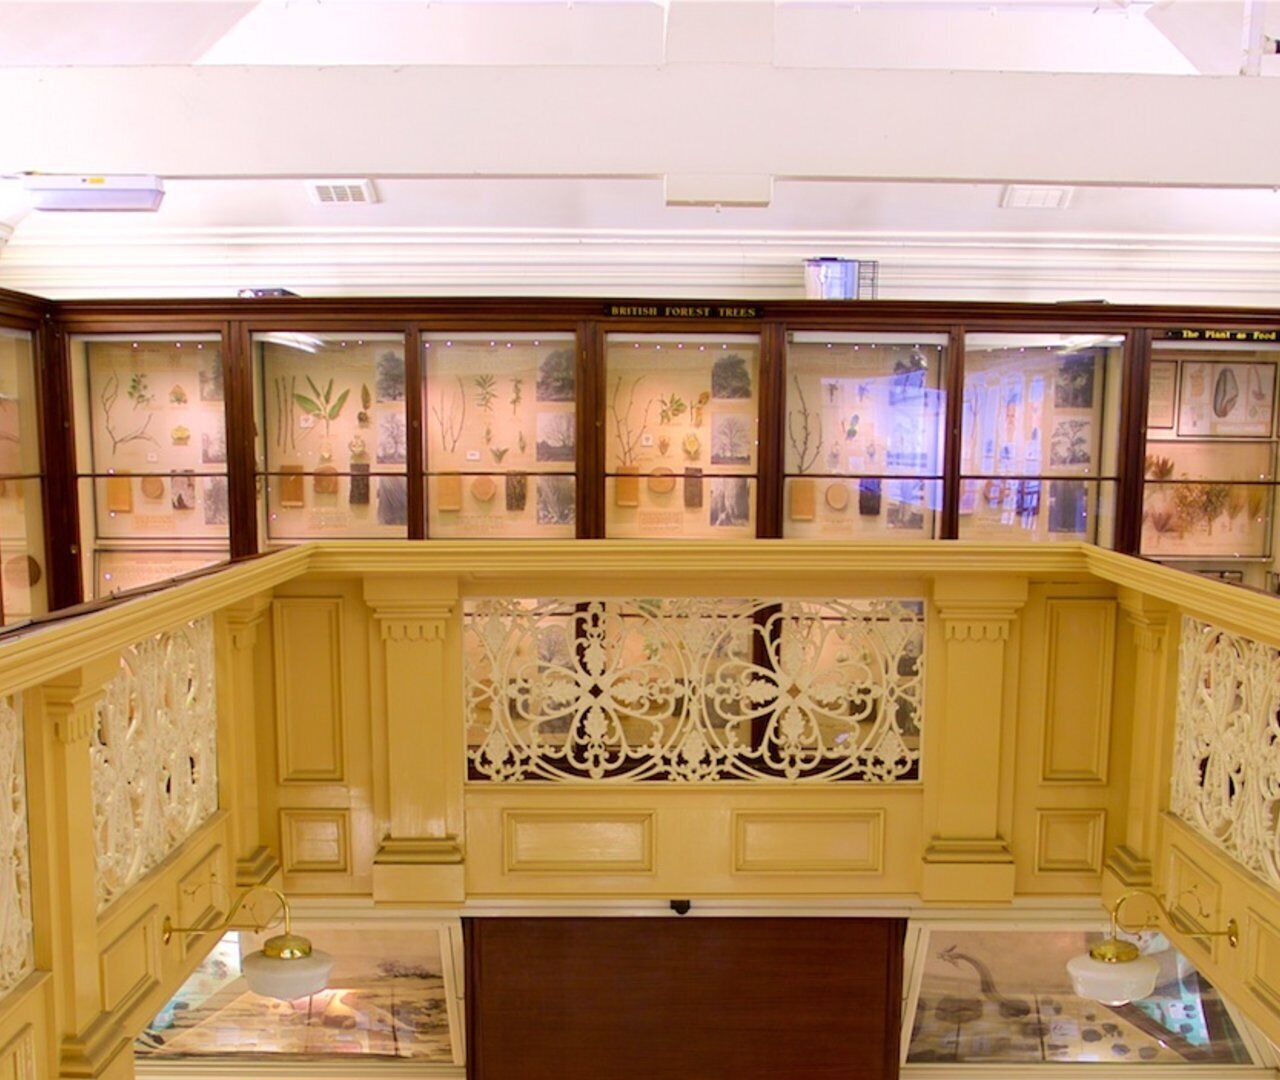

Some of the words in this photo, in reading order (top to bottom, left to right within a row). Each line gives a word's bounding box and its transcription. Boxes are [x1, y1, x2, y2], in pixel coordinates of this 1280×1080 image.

[611, 306, 657, 316] BRITISH
[665, 306, 711, 317] FOREST
[719, 306, 756, 317] TREES
[1182, 329, 1199, 338] The
[1205, 330, 1231, 339] Plant
[1253, 331, 1276, 340] Food
